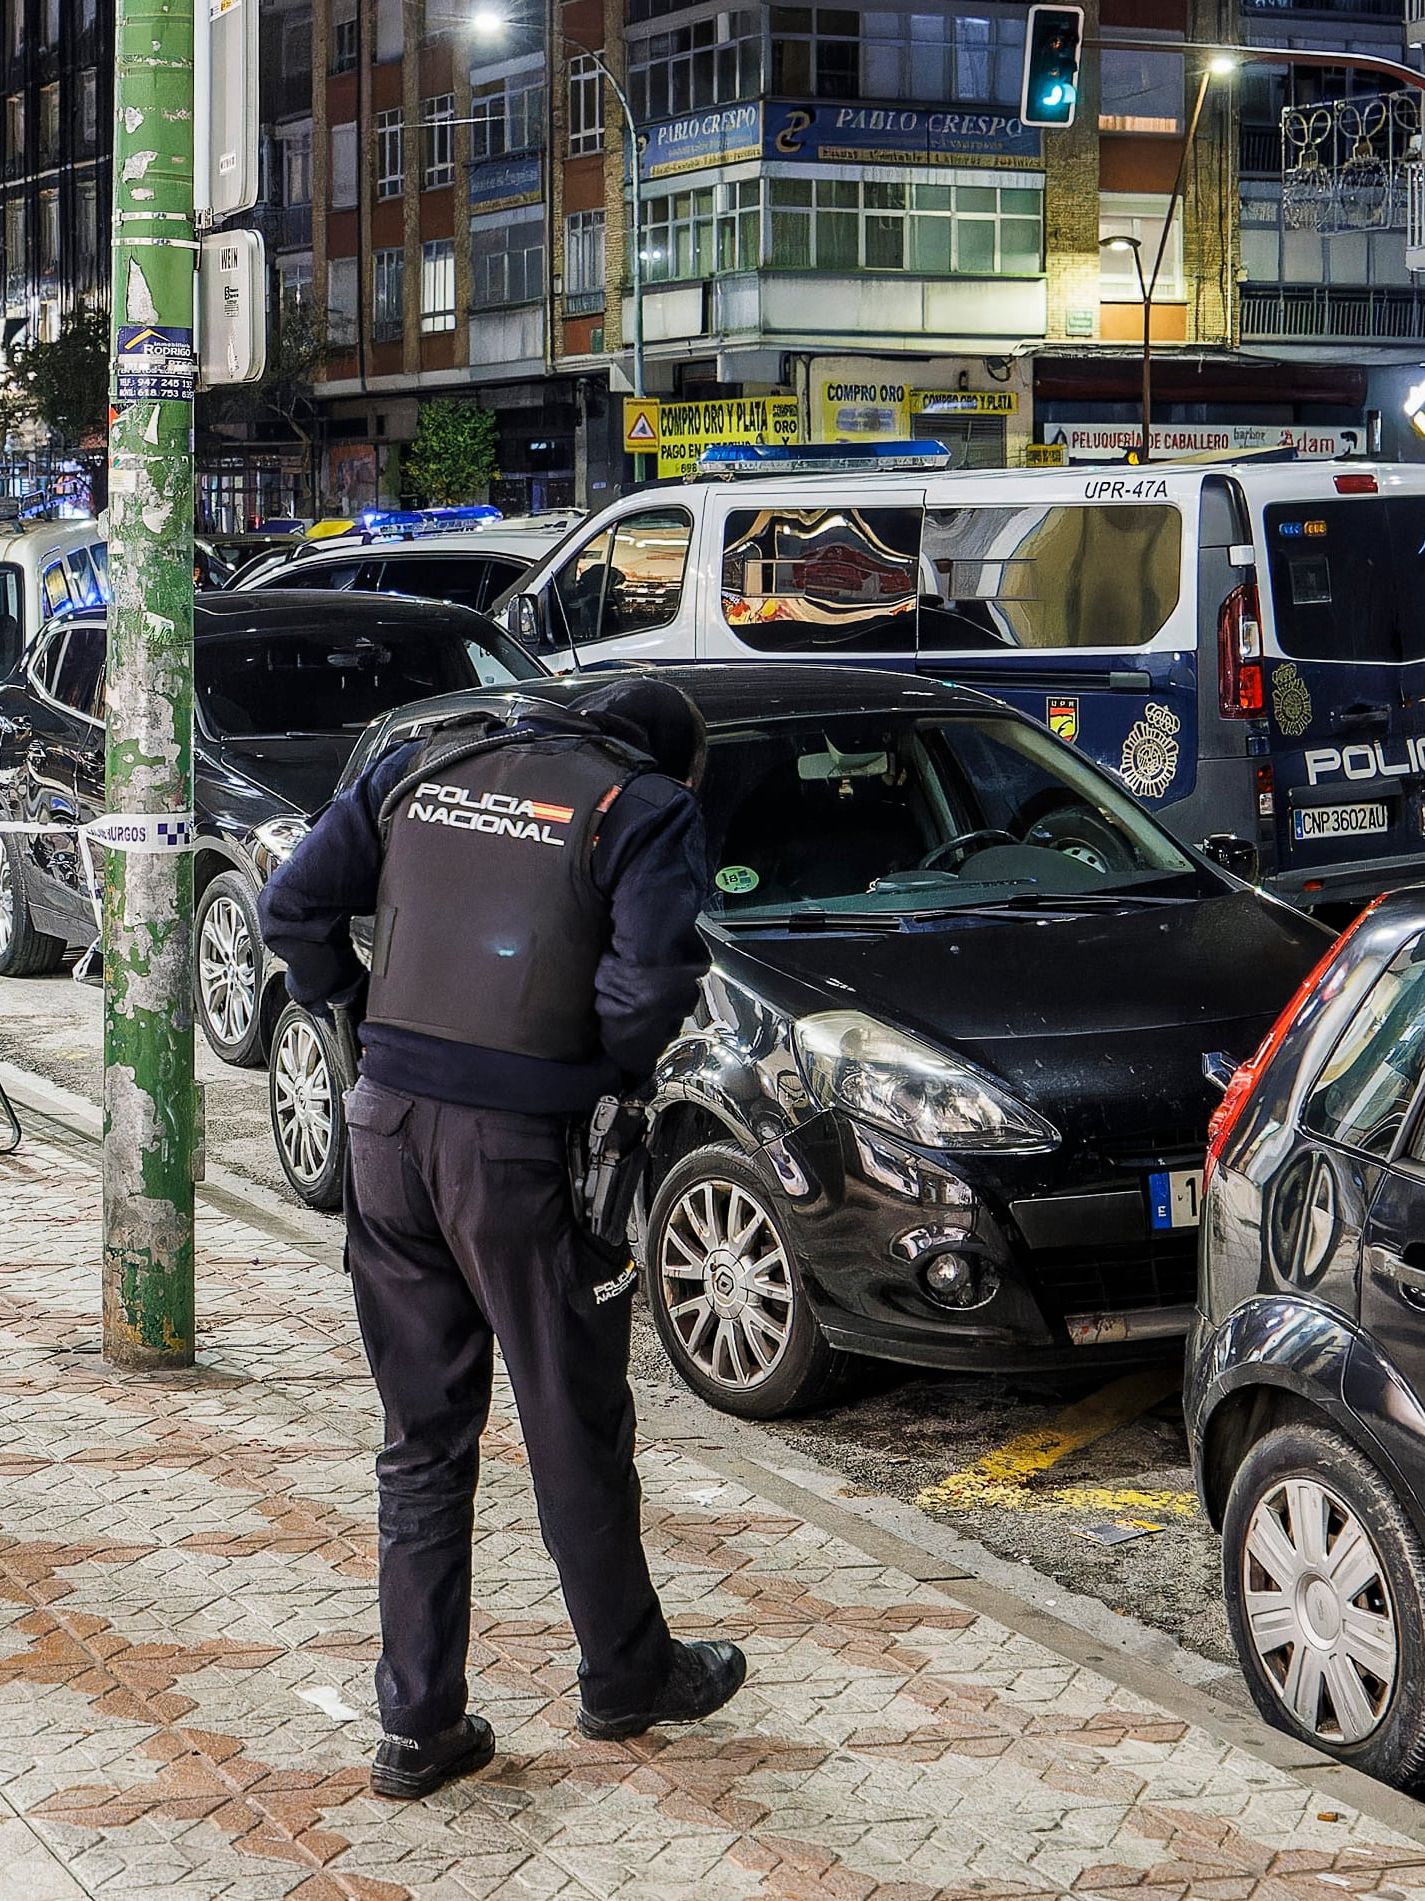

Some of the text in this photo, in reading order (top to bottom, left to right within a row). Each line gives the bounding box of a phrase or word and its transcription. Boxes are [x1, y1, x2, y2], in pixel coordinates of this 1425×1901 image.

[657, 118, 700, 146] PABLO
[702, 105, 757, 135] CRESPO
[836, 108, 1024, 138] PABLO CRESPO
[144, 344, 191, 357] RODRIGO
[137, 378, 157, 387] 947
[161, 379, 179, 388] 245
[161, 389, 179, 397] 753
[827, 384, 876, 401] COMPRO
[880, 385, 904, 403] ORO
[987, 394, 1012, 409] PLATA
[660, 400, 768, 436] COMPRO ORO Y PLATA
[774, 420, 797, 434] ORO
[1164, 433, 1229, 450] CABALLERO
[661, 444, 686, 459] PAGO
[1084, 480, 1167, 499] UPR-47A
[1051, 700, 1075, 708] UPR
[414, 782, 535, 818] POLICIA
[407, 801, 565, 847] NACIONAL
